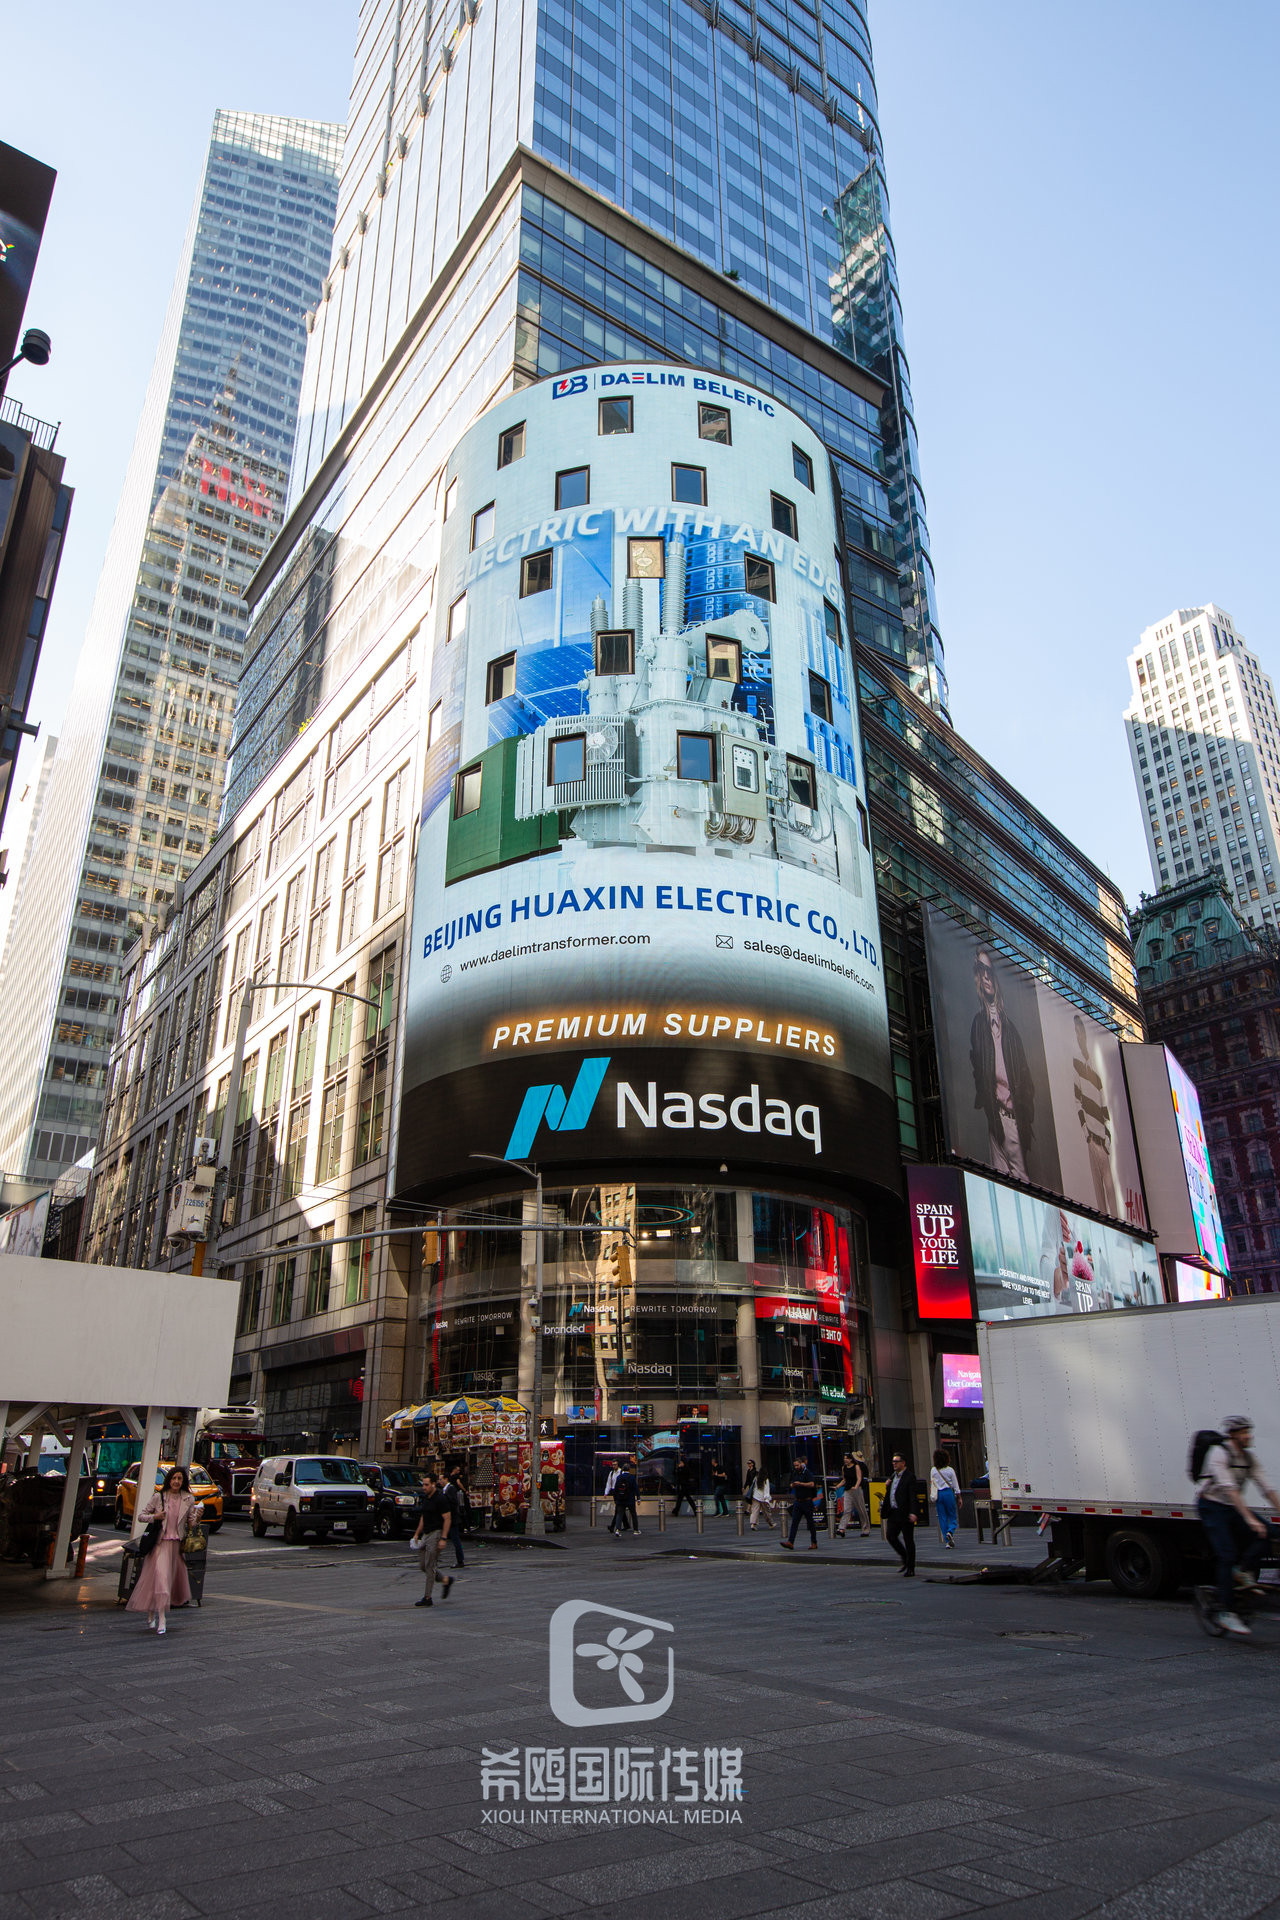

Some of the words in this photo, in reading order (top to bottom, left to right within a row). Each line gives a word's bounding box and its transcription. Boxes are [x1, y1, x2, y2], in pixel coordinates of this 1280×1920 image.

[601, 372, 685, 387] DAELIM
[693, 378, 775, 418] BELEFIC
[453, 509, 602, 592] ELECTRIC
[613, 507, 723, 539] WITH
[730, 522, 784, 562] AN
[422, 904, 501, 959] BEIJING
[510, 885, 644, 924] HUAXIN
[656, 885, 801, 928] ELECTRIC
[460, 933, 650, 972] www.daelimtransformer.com
[744, 938, 876, 993] sales@daelimbelefic.com
[492, 1013, 647, 1050] PREMIUM
[663, 1013, 835, 1056] SUPPLIERS
[616, 1082, 822, 1155] Nasdaq
[916, 1203, 953, 1216] SPAIN
[1125, 1187, 1144, 1228] H&M
[919, 1216, 956, 1238] UP
[919, 1237, 957, 1250] YOUR
[921, 1249, 959, 1265] LIFE
[998, 1268, 1019, 1280] CREATIVITY
[1019, 1273, 1027, 1282] AND
[1075, 1280, 1092, 1295] SPAIN
[583, 1304, 615, 1314] Nasdaq
[631, 1305, 667, 1313] REWRITE
[670, 1305, 718, 1314] TOMORROW
[1077, 1292, 1093, 1313] UP
[477, 1312, 513, 1322] TOMORROW
[627, 1363, 673, 1377] Nasdaq
[783, 1367, 804, 1379] Nasdaq
